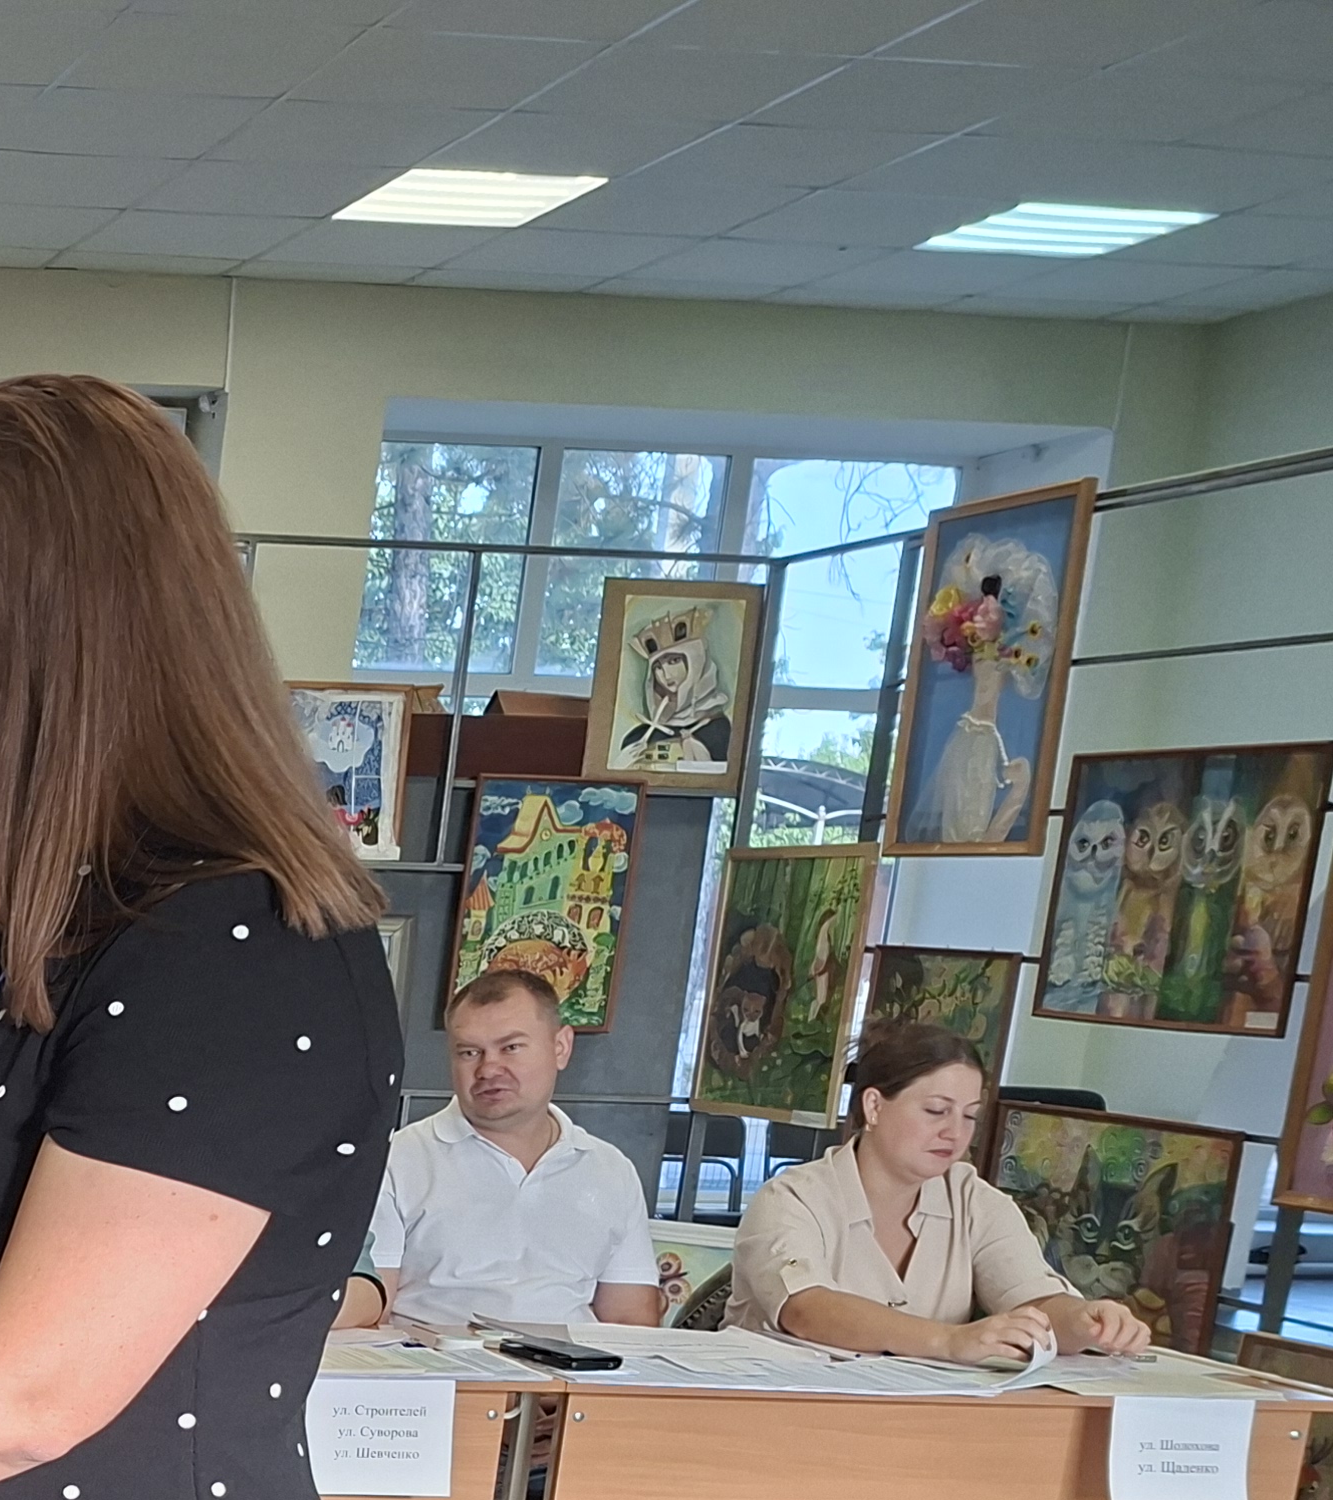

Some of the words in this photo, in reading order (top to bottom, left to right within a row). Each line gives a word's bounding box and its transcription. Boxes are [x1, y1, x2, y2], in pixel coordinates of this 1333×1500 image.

[332, 1407, 350, 1417] ул.
[355, 1405, 427, 1419] Строителей
[337, 1428, 355, 1439] ул.
[360, 1426, 418, 1440] Суворова
[1139, 1442, 1156, 1452] ул.
[1160, 1440, 1220, 1451] Шолохова
[334, 1450, 351, 1460] ул.
[356, 1447, 419, 1459] Шевченко
[1137, 1464, 1156, 1475] ул.
